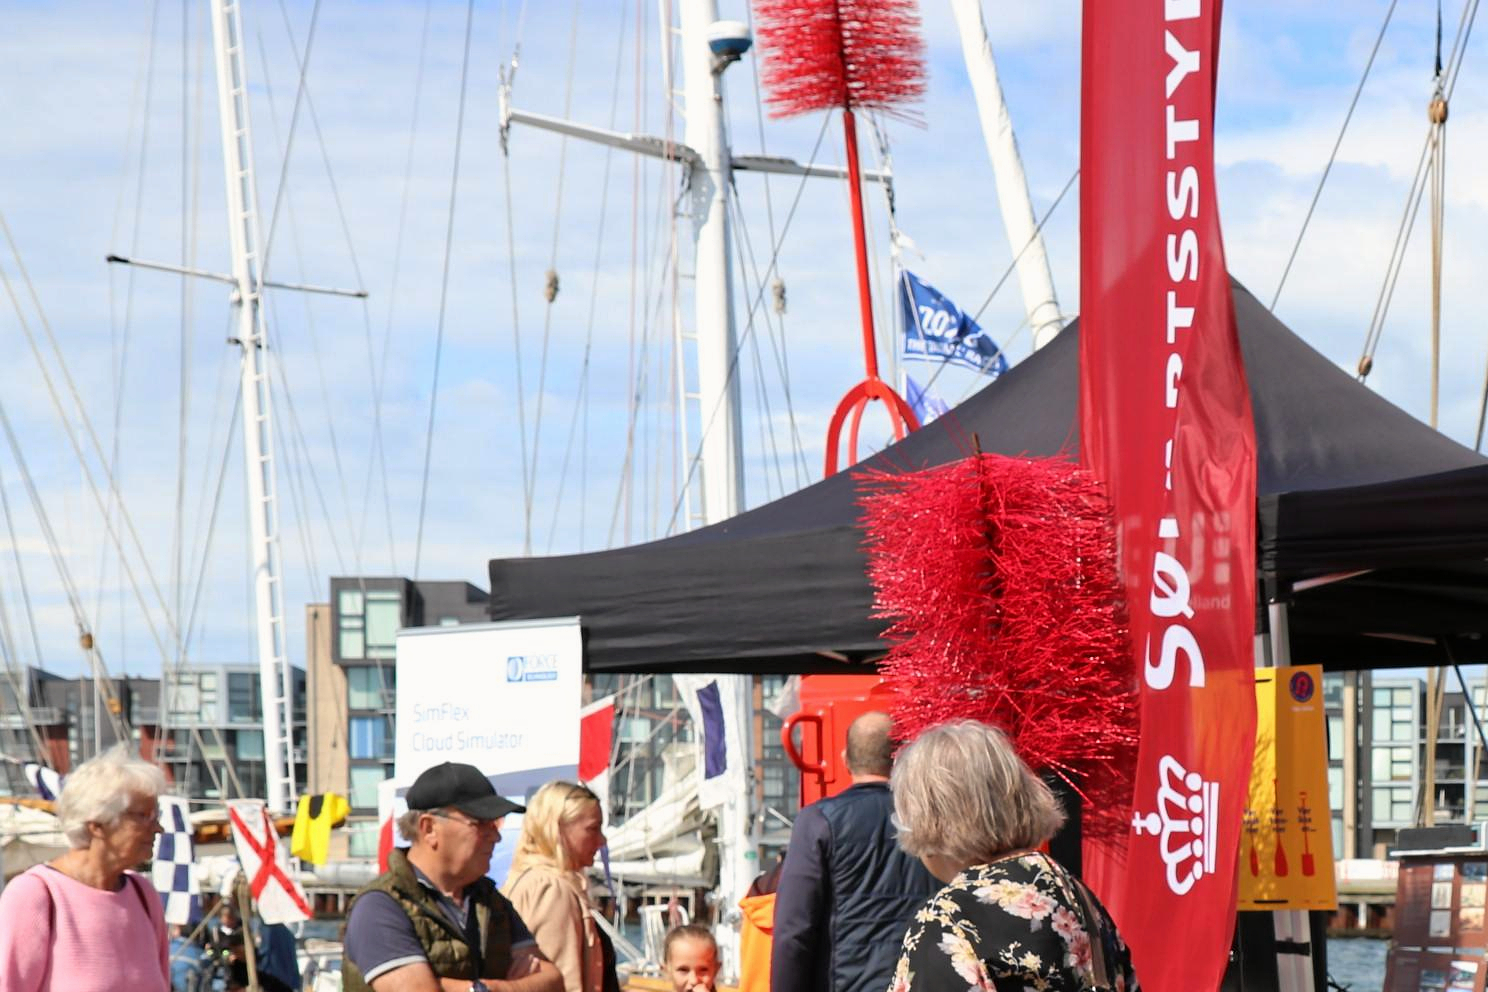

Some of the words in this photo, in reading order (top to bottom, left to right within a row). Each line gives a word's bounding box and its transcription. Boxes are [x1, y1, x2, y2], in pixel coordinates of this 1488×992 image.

[413, 703, 469, 724] SimFlex
[412, 732, 453, 752] Cloud
[457, 729, 523, 751] Simulator
